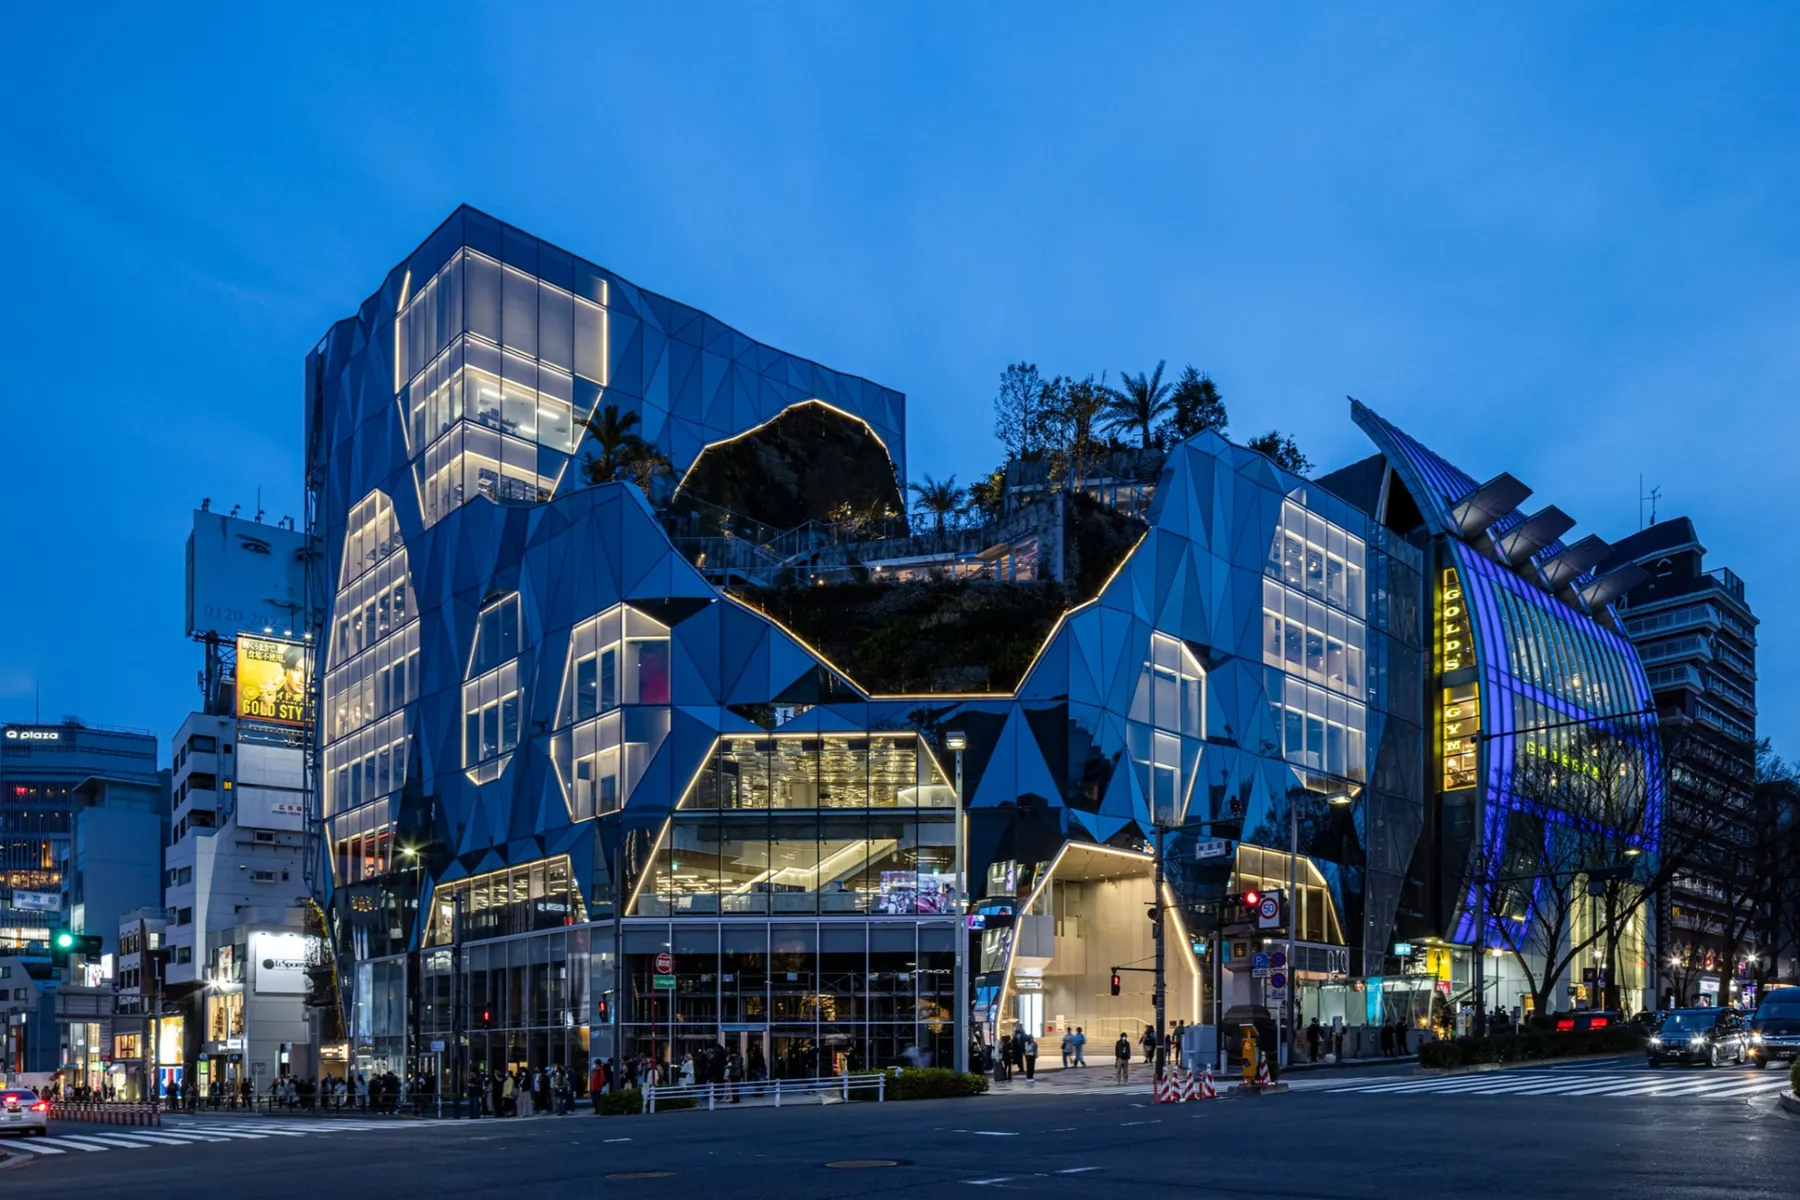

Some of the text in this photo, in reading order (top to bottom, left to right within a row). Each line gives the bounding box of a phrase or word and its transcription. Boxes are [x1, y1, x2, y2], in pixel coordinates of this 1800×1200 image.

[1443, 589, 1461, 671] GOLD'S
[242, 699, 304, 720] GOLD STY
[6, 730, 59, 740] Q plaza
[1445, 707, 1462, 751] GYM
[1263, 902, 1275, 914] 50
[1255, 955, 1263, 967] P
